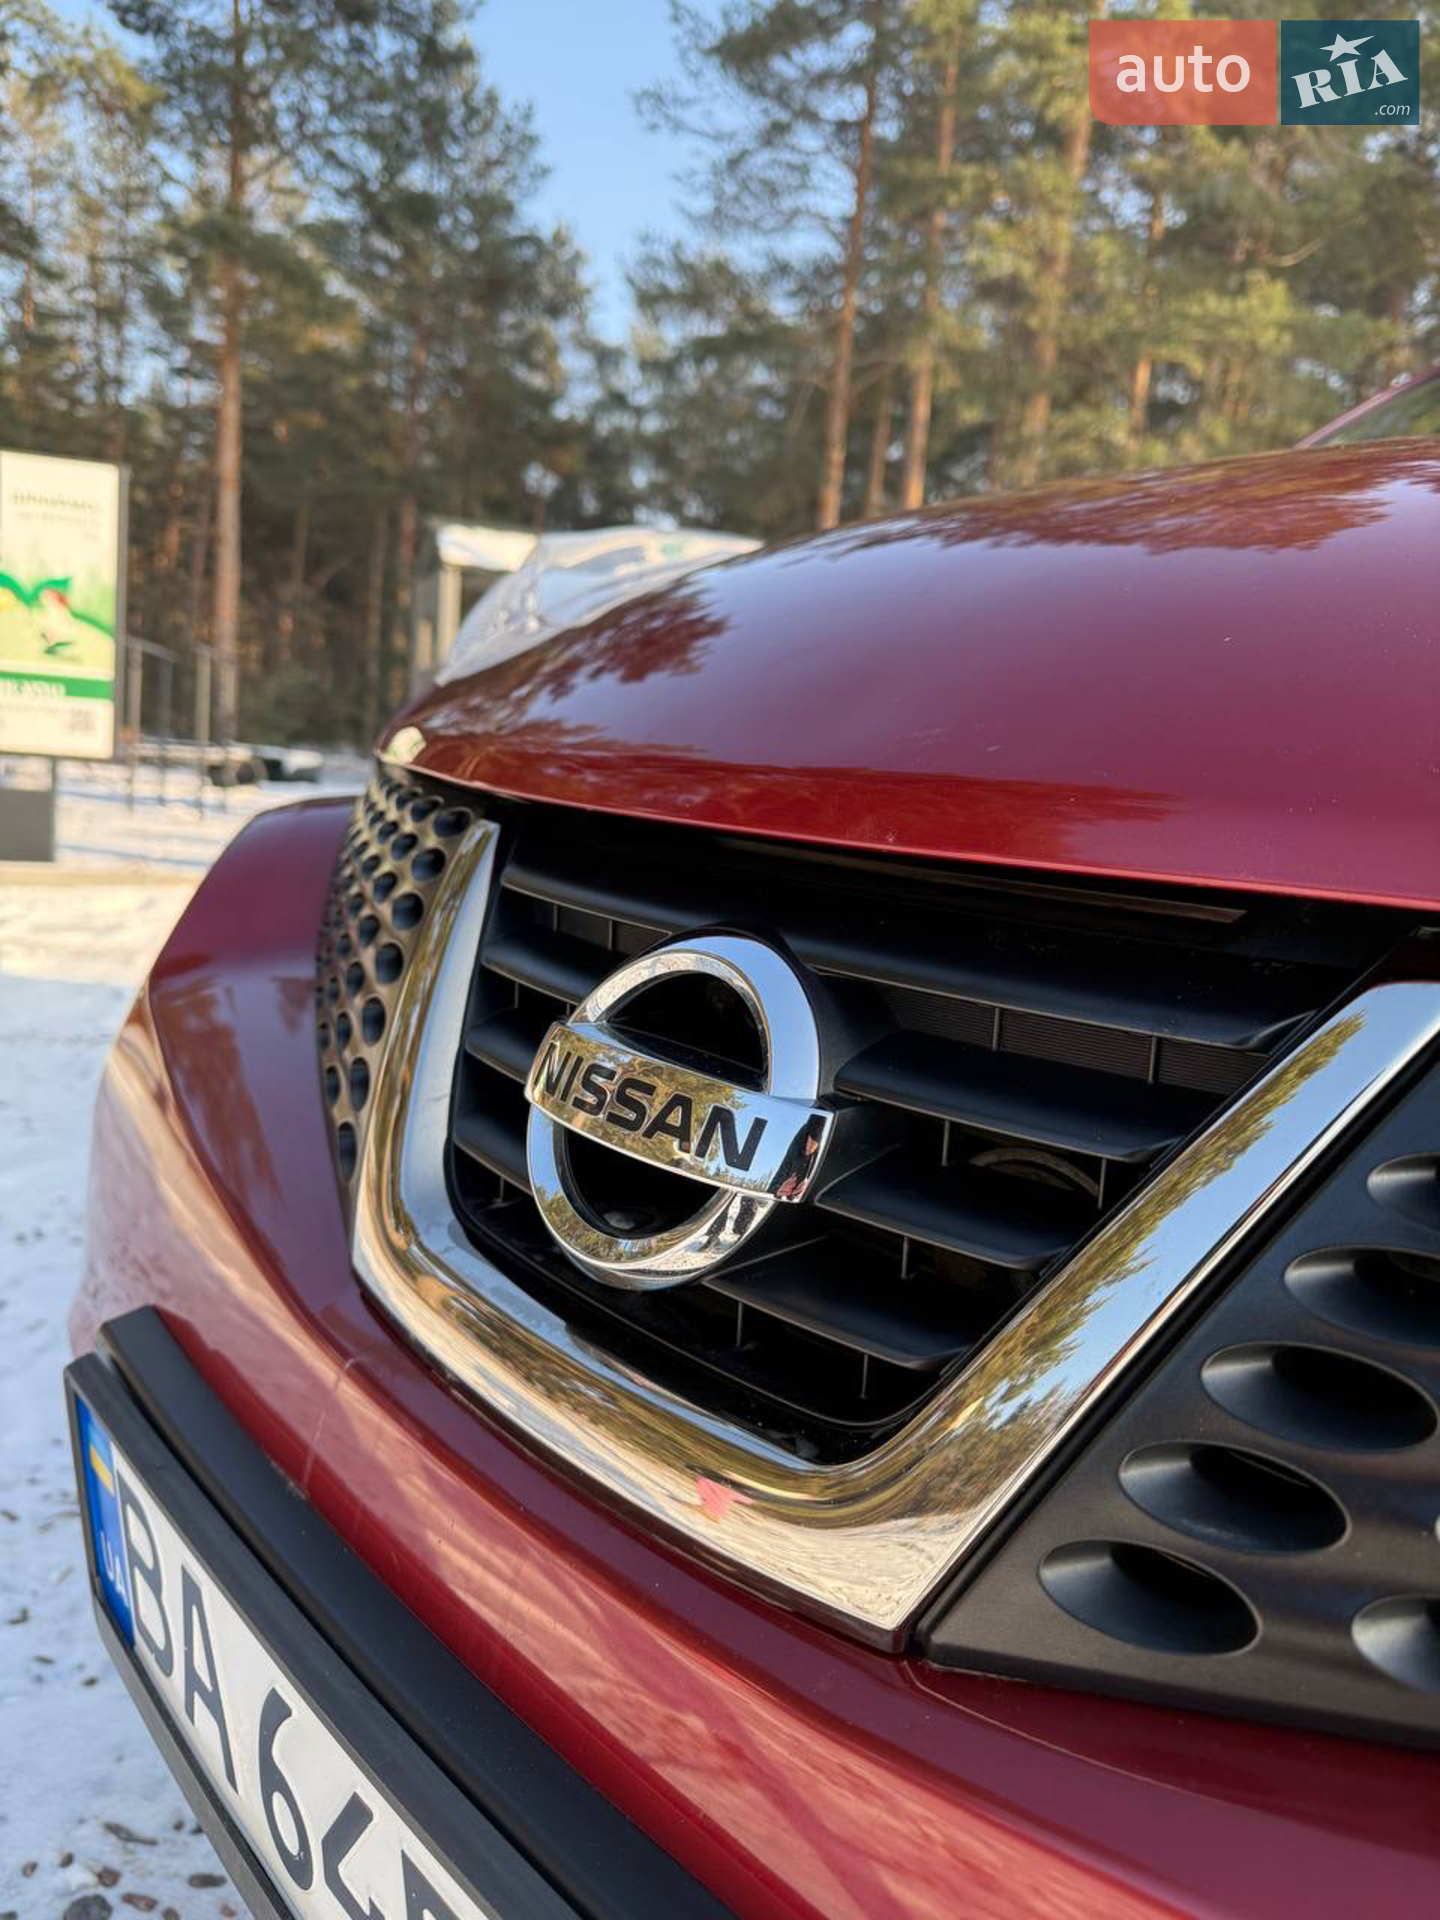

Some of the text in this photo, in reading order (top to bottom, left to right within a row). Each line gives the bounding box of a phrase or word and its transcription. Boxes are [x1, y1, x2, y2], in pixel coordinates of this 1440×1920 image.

[533, 1041, 768, 1172] NISSAN
[99, 1529, 129, 1608] UA
[116, 1468, 461, 1920] BA 64
